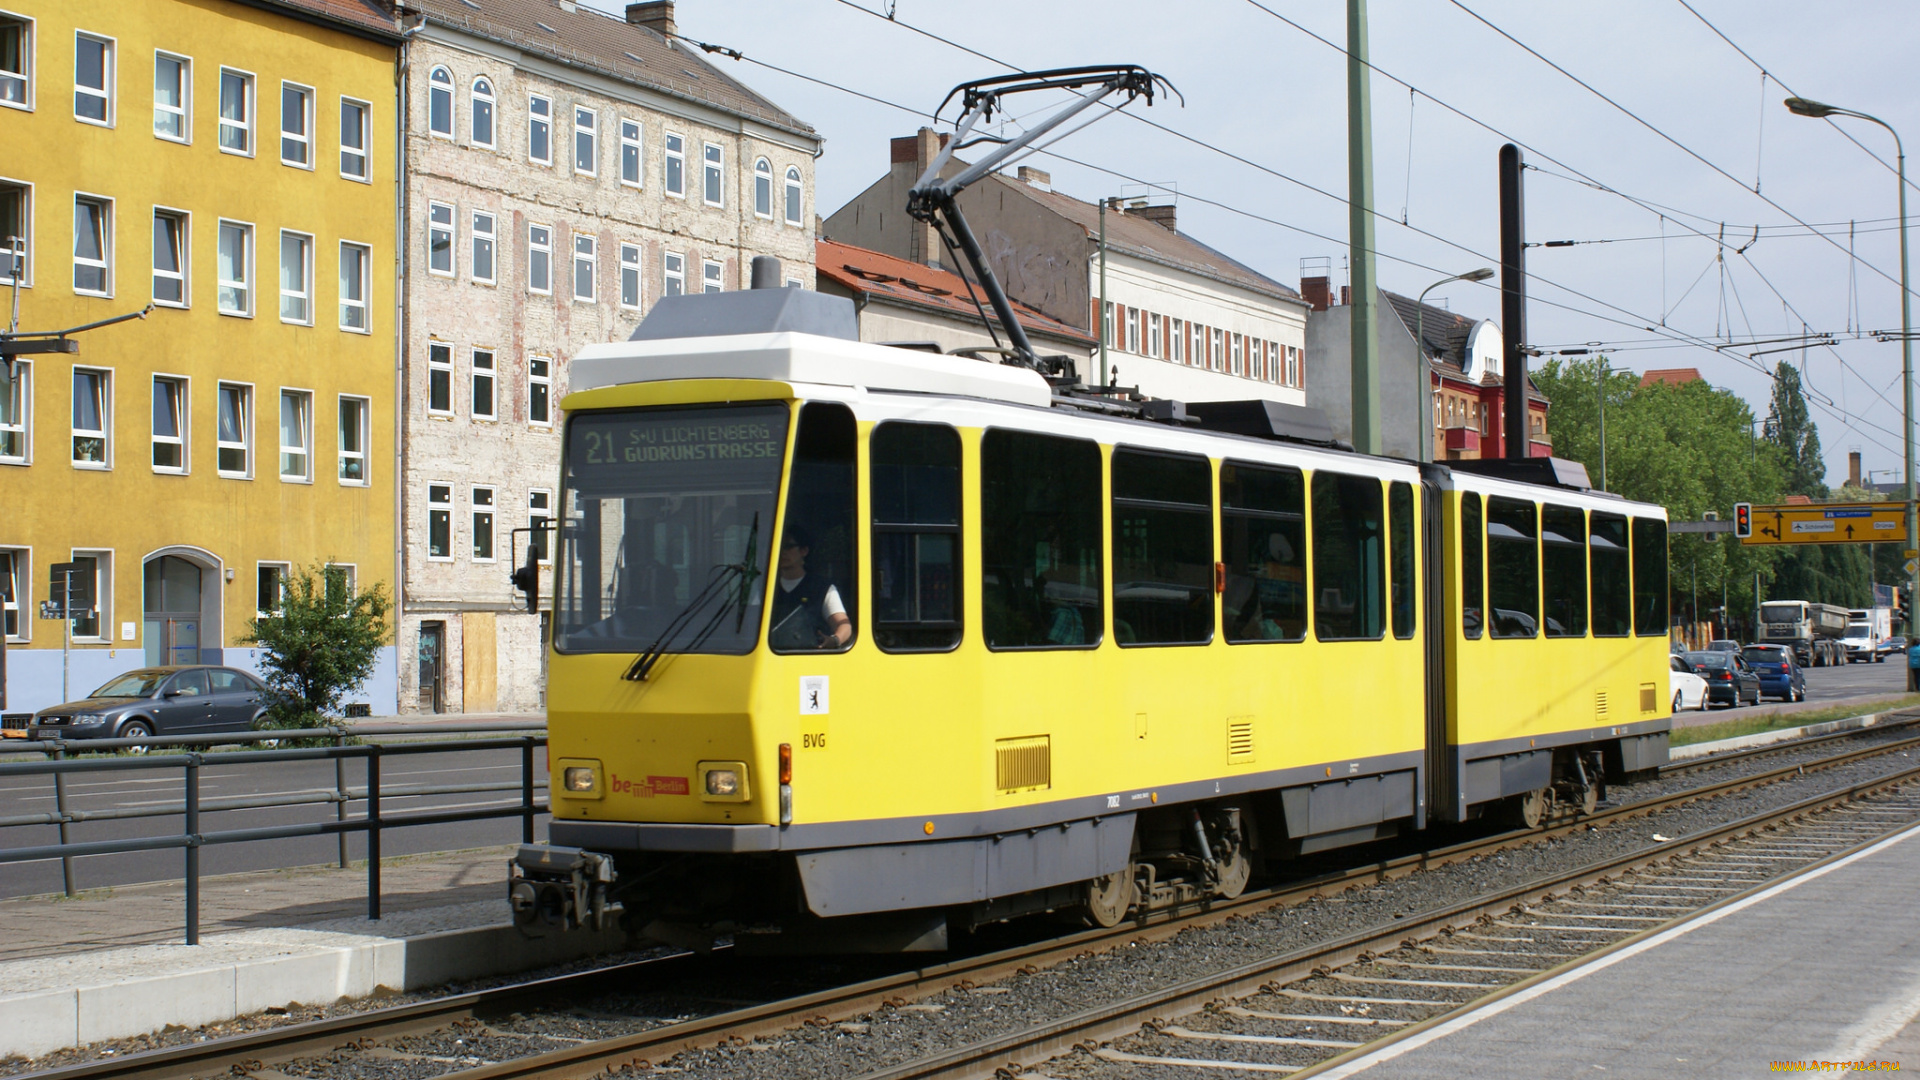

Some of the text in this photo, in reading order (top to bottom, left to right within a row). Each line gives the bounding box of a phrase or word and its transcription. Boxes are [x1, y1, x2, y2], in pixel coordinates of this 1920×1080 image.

[629, 423, 770, 445] S+U LICHTENBERG
[584, 431, 618, 464] 21
[624, 441, 779, 463] GUDRUNSTRASSE
[803, 733, 826, 748] BVG
[611, 774, 686, 793] be Berlin
